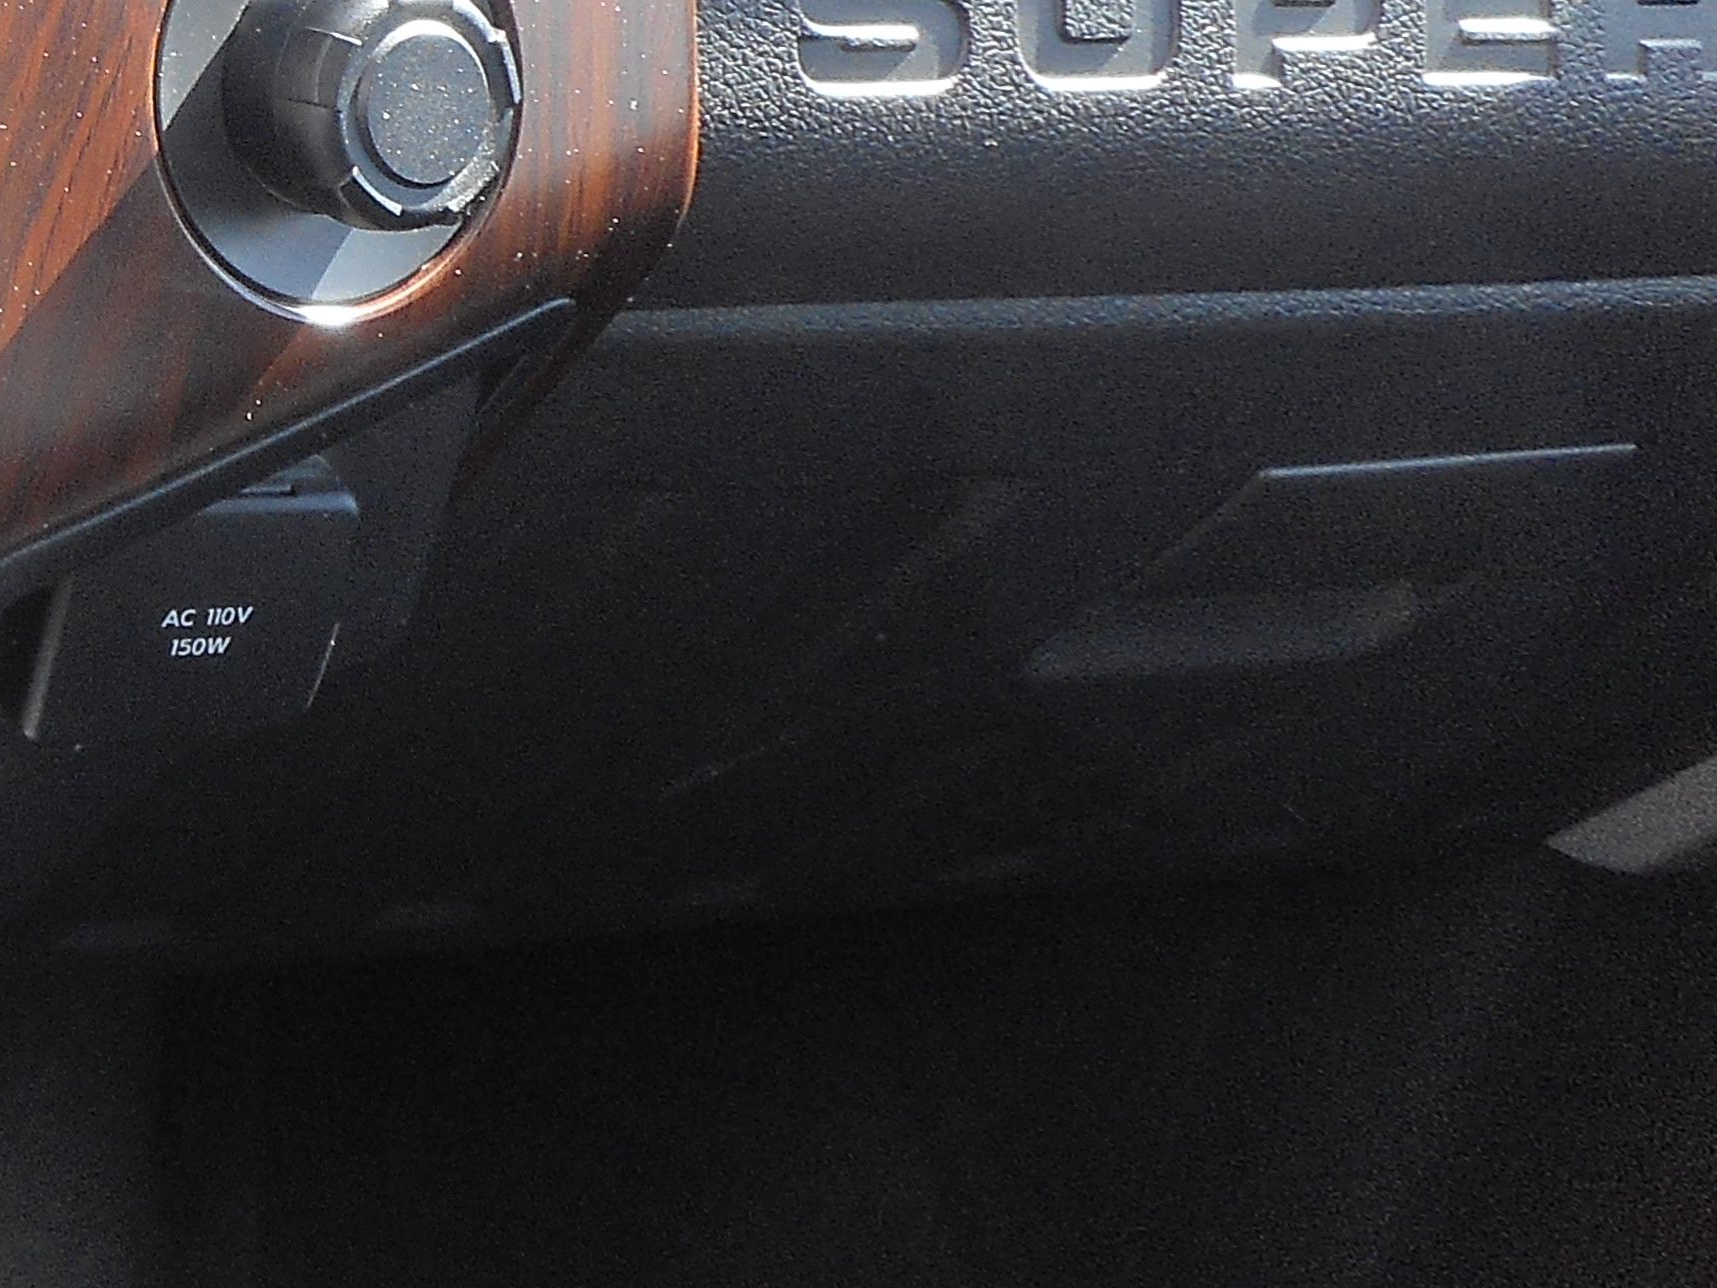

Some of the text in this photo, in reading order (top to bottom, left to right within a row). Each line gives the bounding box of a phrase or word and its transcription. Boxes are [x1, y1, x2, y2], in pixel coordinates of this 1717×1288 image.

[161, 606, 254, 628] AC 110V
[170, 636, 232, 657] 150W
